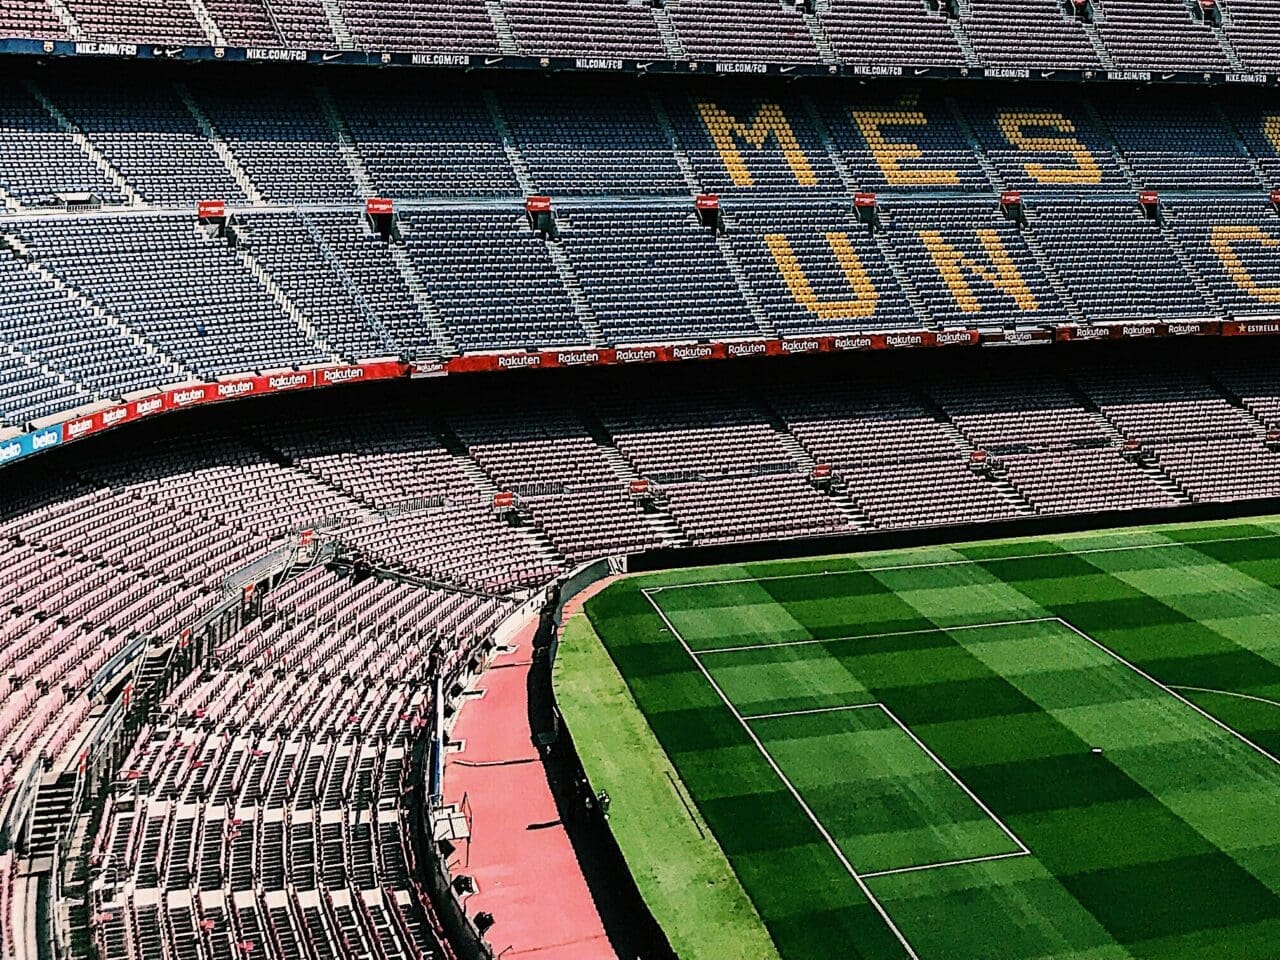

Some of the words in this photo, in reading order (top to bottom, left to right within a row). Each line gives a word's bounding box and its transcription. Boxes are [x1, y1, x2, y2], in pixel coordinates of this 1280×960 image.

[76, 43, 137, 55] NIKE.COM/FCB
[246, 48, 307, 61] NIKE.COM/FCB
[412, 54, 469, 65] NIKE.COM/FCB
[716, 63, 767, 73] NIKE.COM/FCB
[854, 66, 902, 76] NIKE.COM/FCB
[984, 68, 1029, 78] NIKE.COM/FCB
[1107, 71, 1151, 81] NIKE.COM/FCB
[764, 230, 1039, 319] UN
[1076, 328, 1110, 337] Rakuten
[1122, 326, 1155, 335] Rakuten
[1168, 324, 1201, 333] Rakuten
[886, 336, 922, 345] Rakuten
[936, 332, 971, 342] Rakuten
[782, 341, 819, 351] Rakuten
[835, 338, 872, 348] Rakuten
[673, 347, 713, 358] Rakuten
[728, 344, 766, 354] Rakuten
[499, 354, 540, 367] Rakuten
[558, 351, 599, 363] Rakuten
[616, 350, 656, 361] Rakuten
[324, 368, 363, 381] Rakuten
[269, 374, 307, 389] Rakuten
[218, 381, 254, 395] Rakuten
[174, 389, 205, 403] Rakuten
[33, 430, 58, 450] beko
